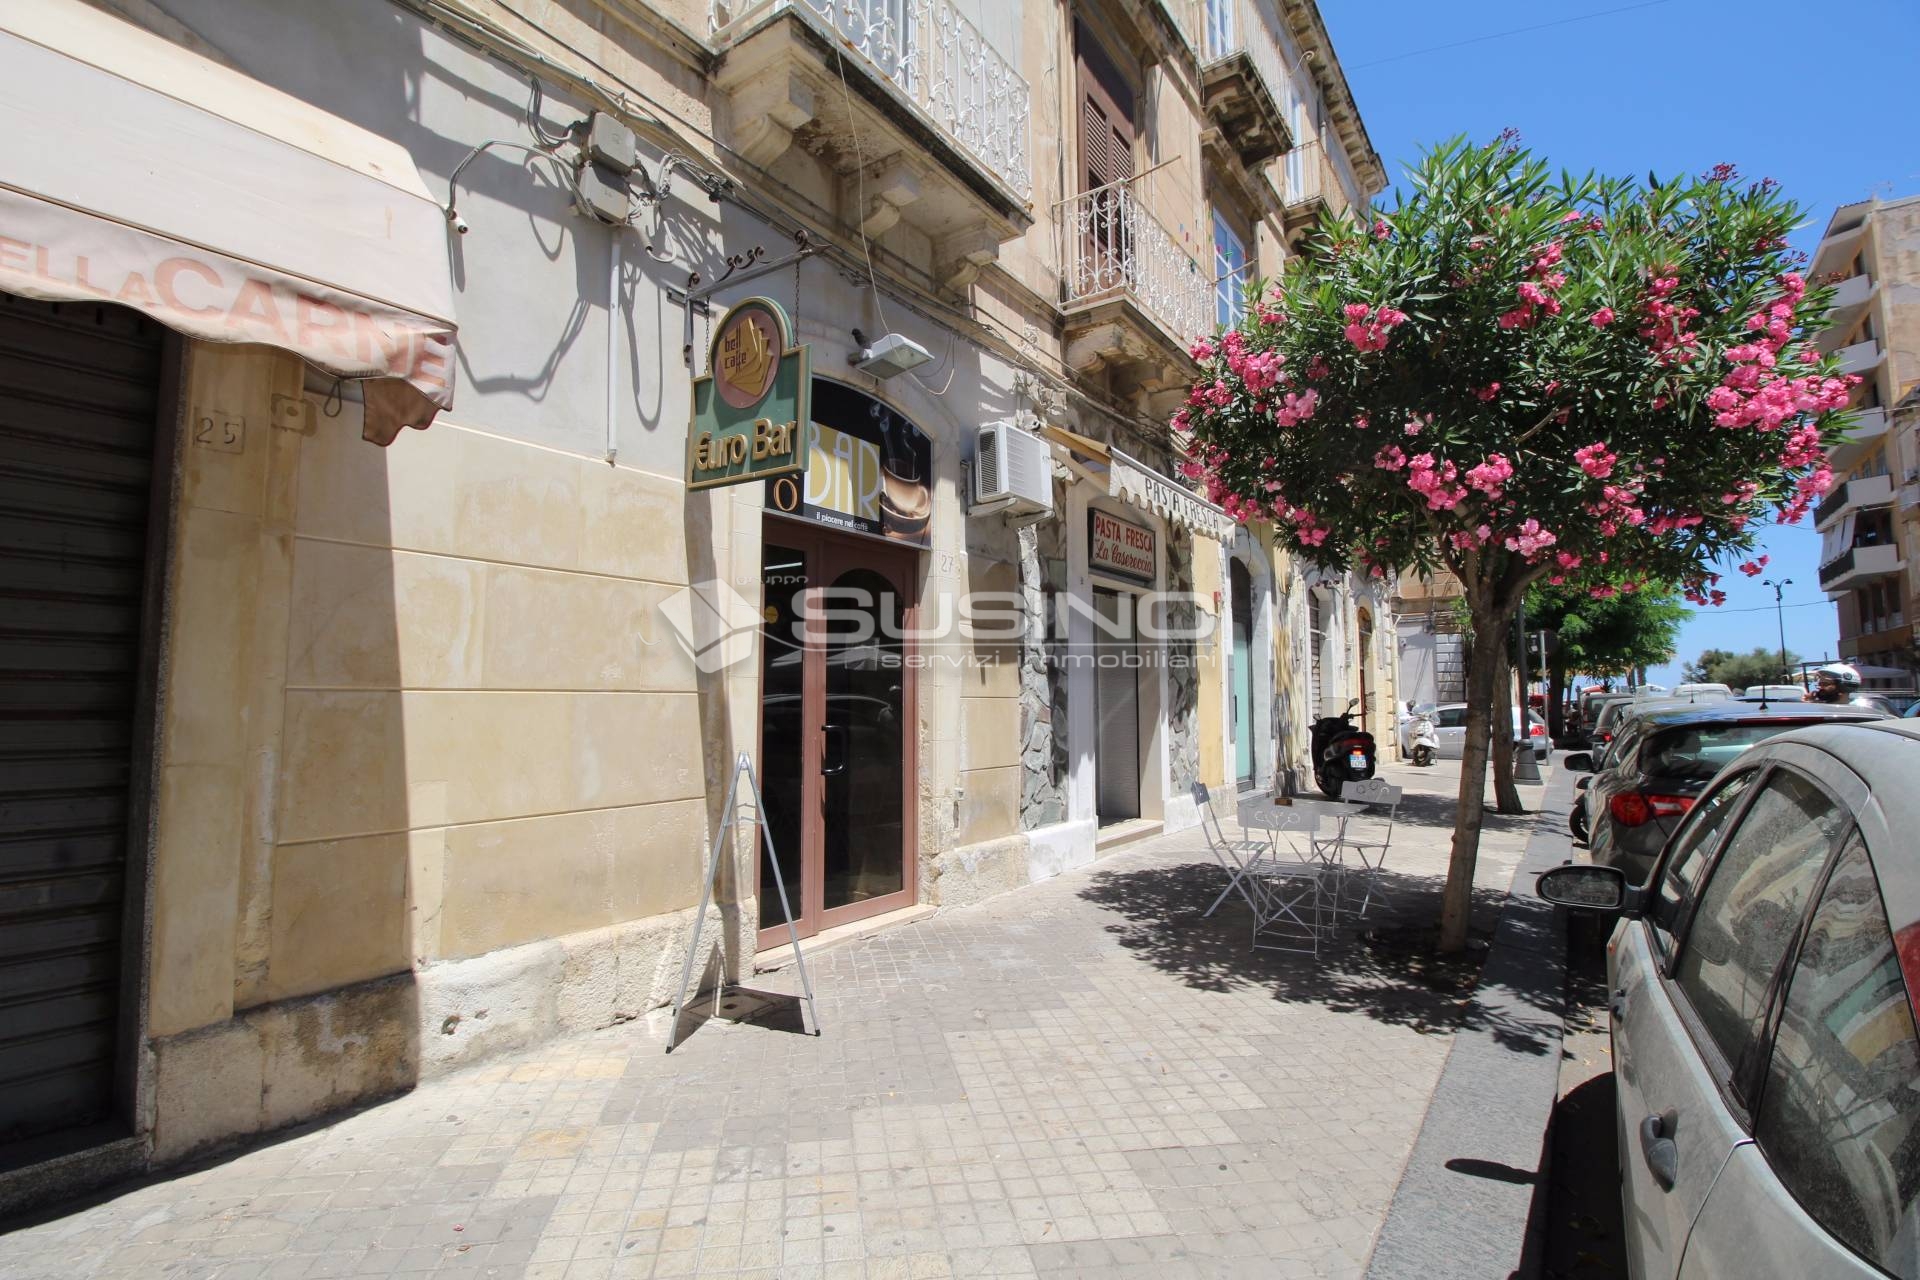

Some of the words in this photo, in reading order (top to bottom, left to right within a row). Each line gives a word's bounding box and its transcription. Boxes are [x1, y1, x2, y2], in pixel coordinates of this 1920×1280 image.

[153, 257, 446, 387] CARNE
[196, 417, 239, 444] 25
[752, 418, 797, 461] Bar
[803, 420, 882, 522] BAR
[821, 513, 843, 527] piacere
[844, 519, 853, 528] nel
[1145, 477, 1180, 512] PASTA
[1184, 498, 1218, 530] FRESCA
[1095, 515, 1121, 543] PASTA
[1125, 527, 1152, 554] FRESCA
[1095, 539, 1108, 561] La
